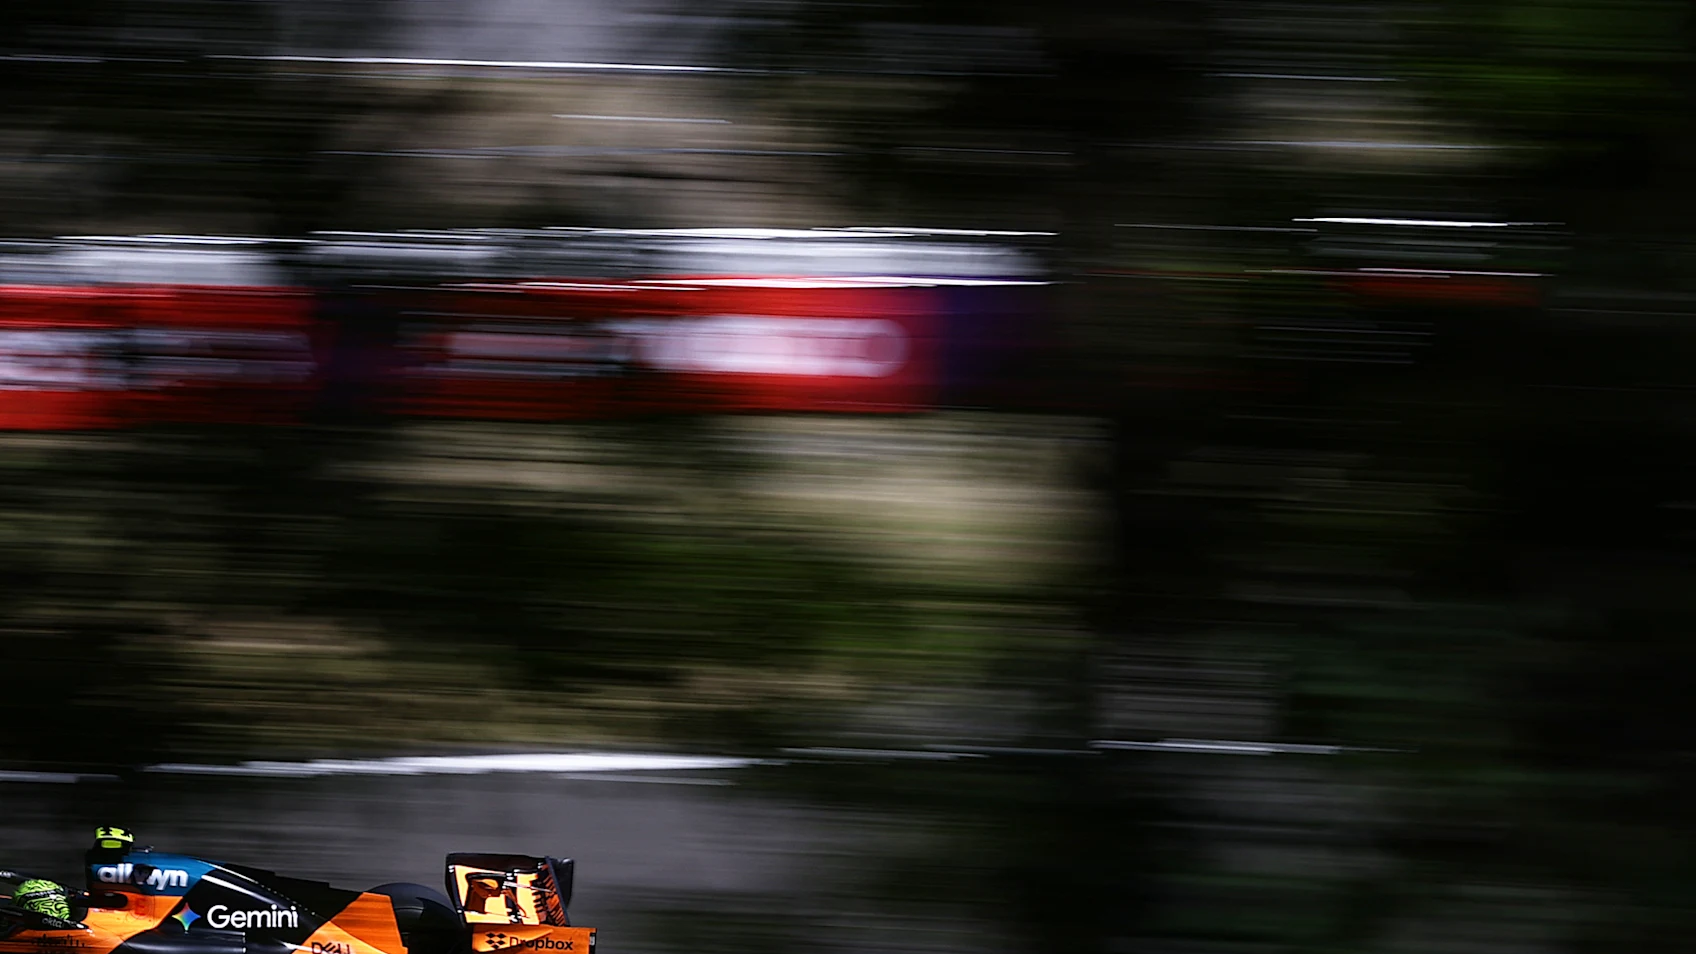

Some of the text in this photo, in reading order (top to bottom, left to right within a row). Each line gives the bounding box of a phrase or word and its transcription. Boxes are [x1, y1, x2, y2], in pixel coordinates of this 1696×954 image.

[41, 916, 63, 928] okta
[206, 903, 299, 929] Gemini
[509, 936, 574, 951] Dropbox
